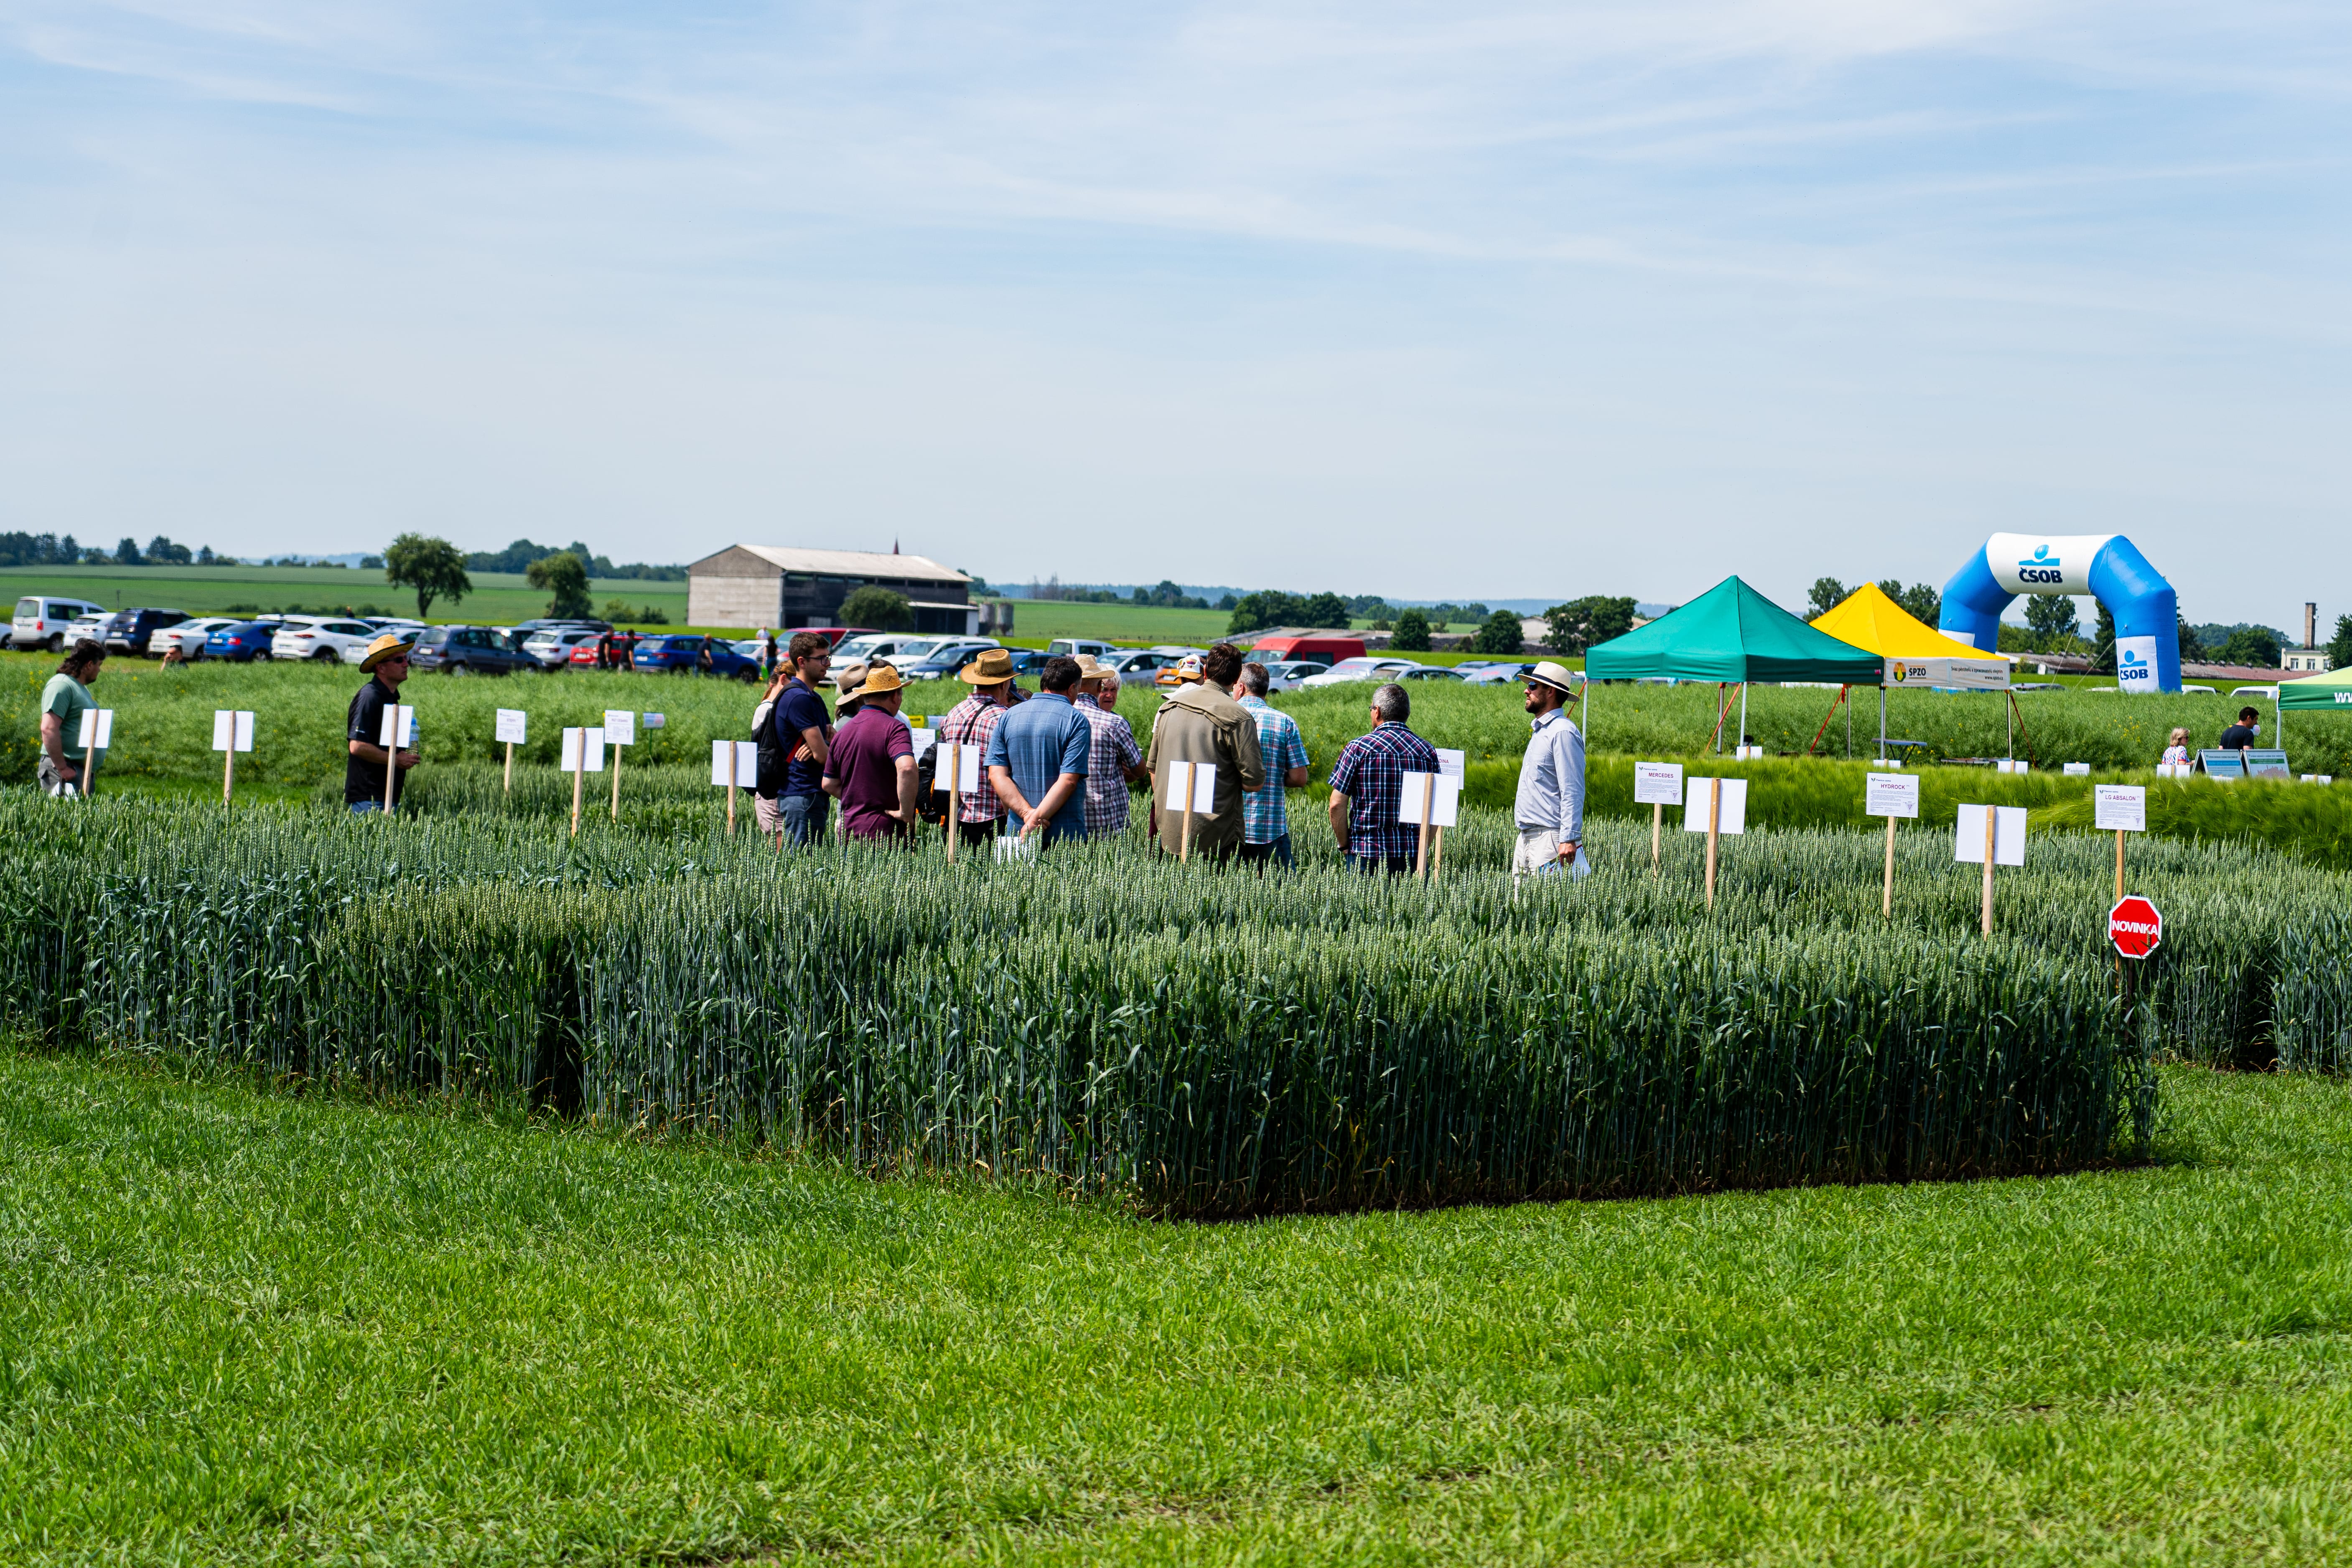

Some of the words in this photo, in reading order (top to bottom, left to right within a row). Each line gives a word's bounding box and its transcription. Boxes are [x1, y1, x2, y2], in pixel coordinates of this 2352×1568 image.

[2019, 567, 2063, 583] ČSOB
[1909, 667, 1926, 676] SPZO
[2112, 920, 2158, 935] NOVINKA
